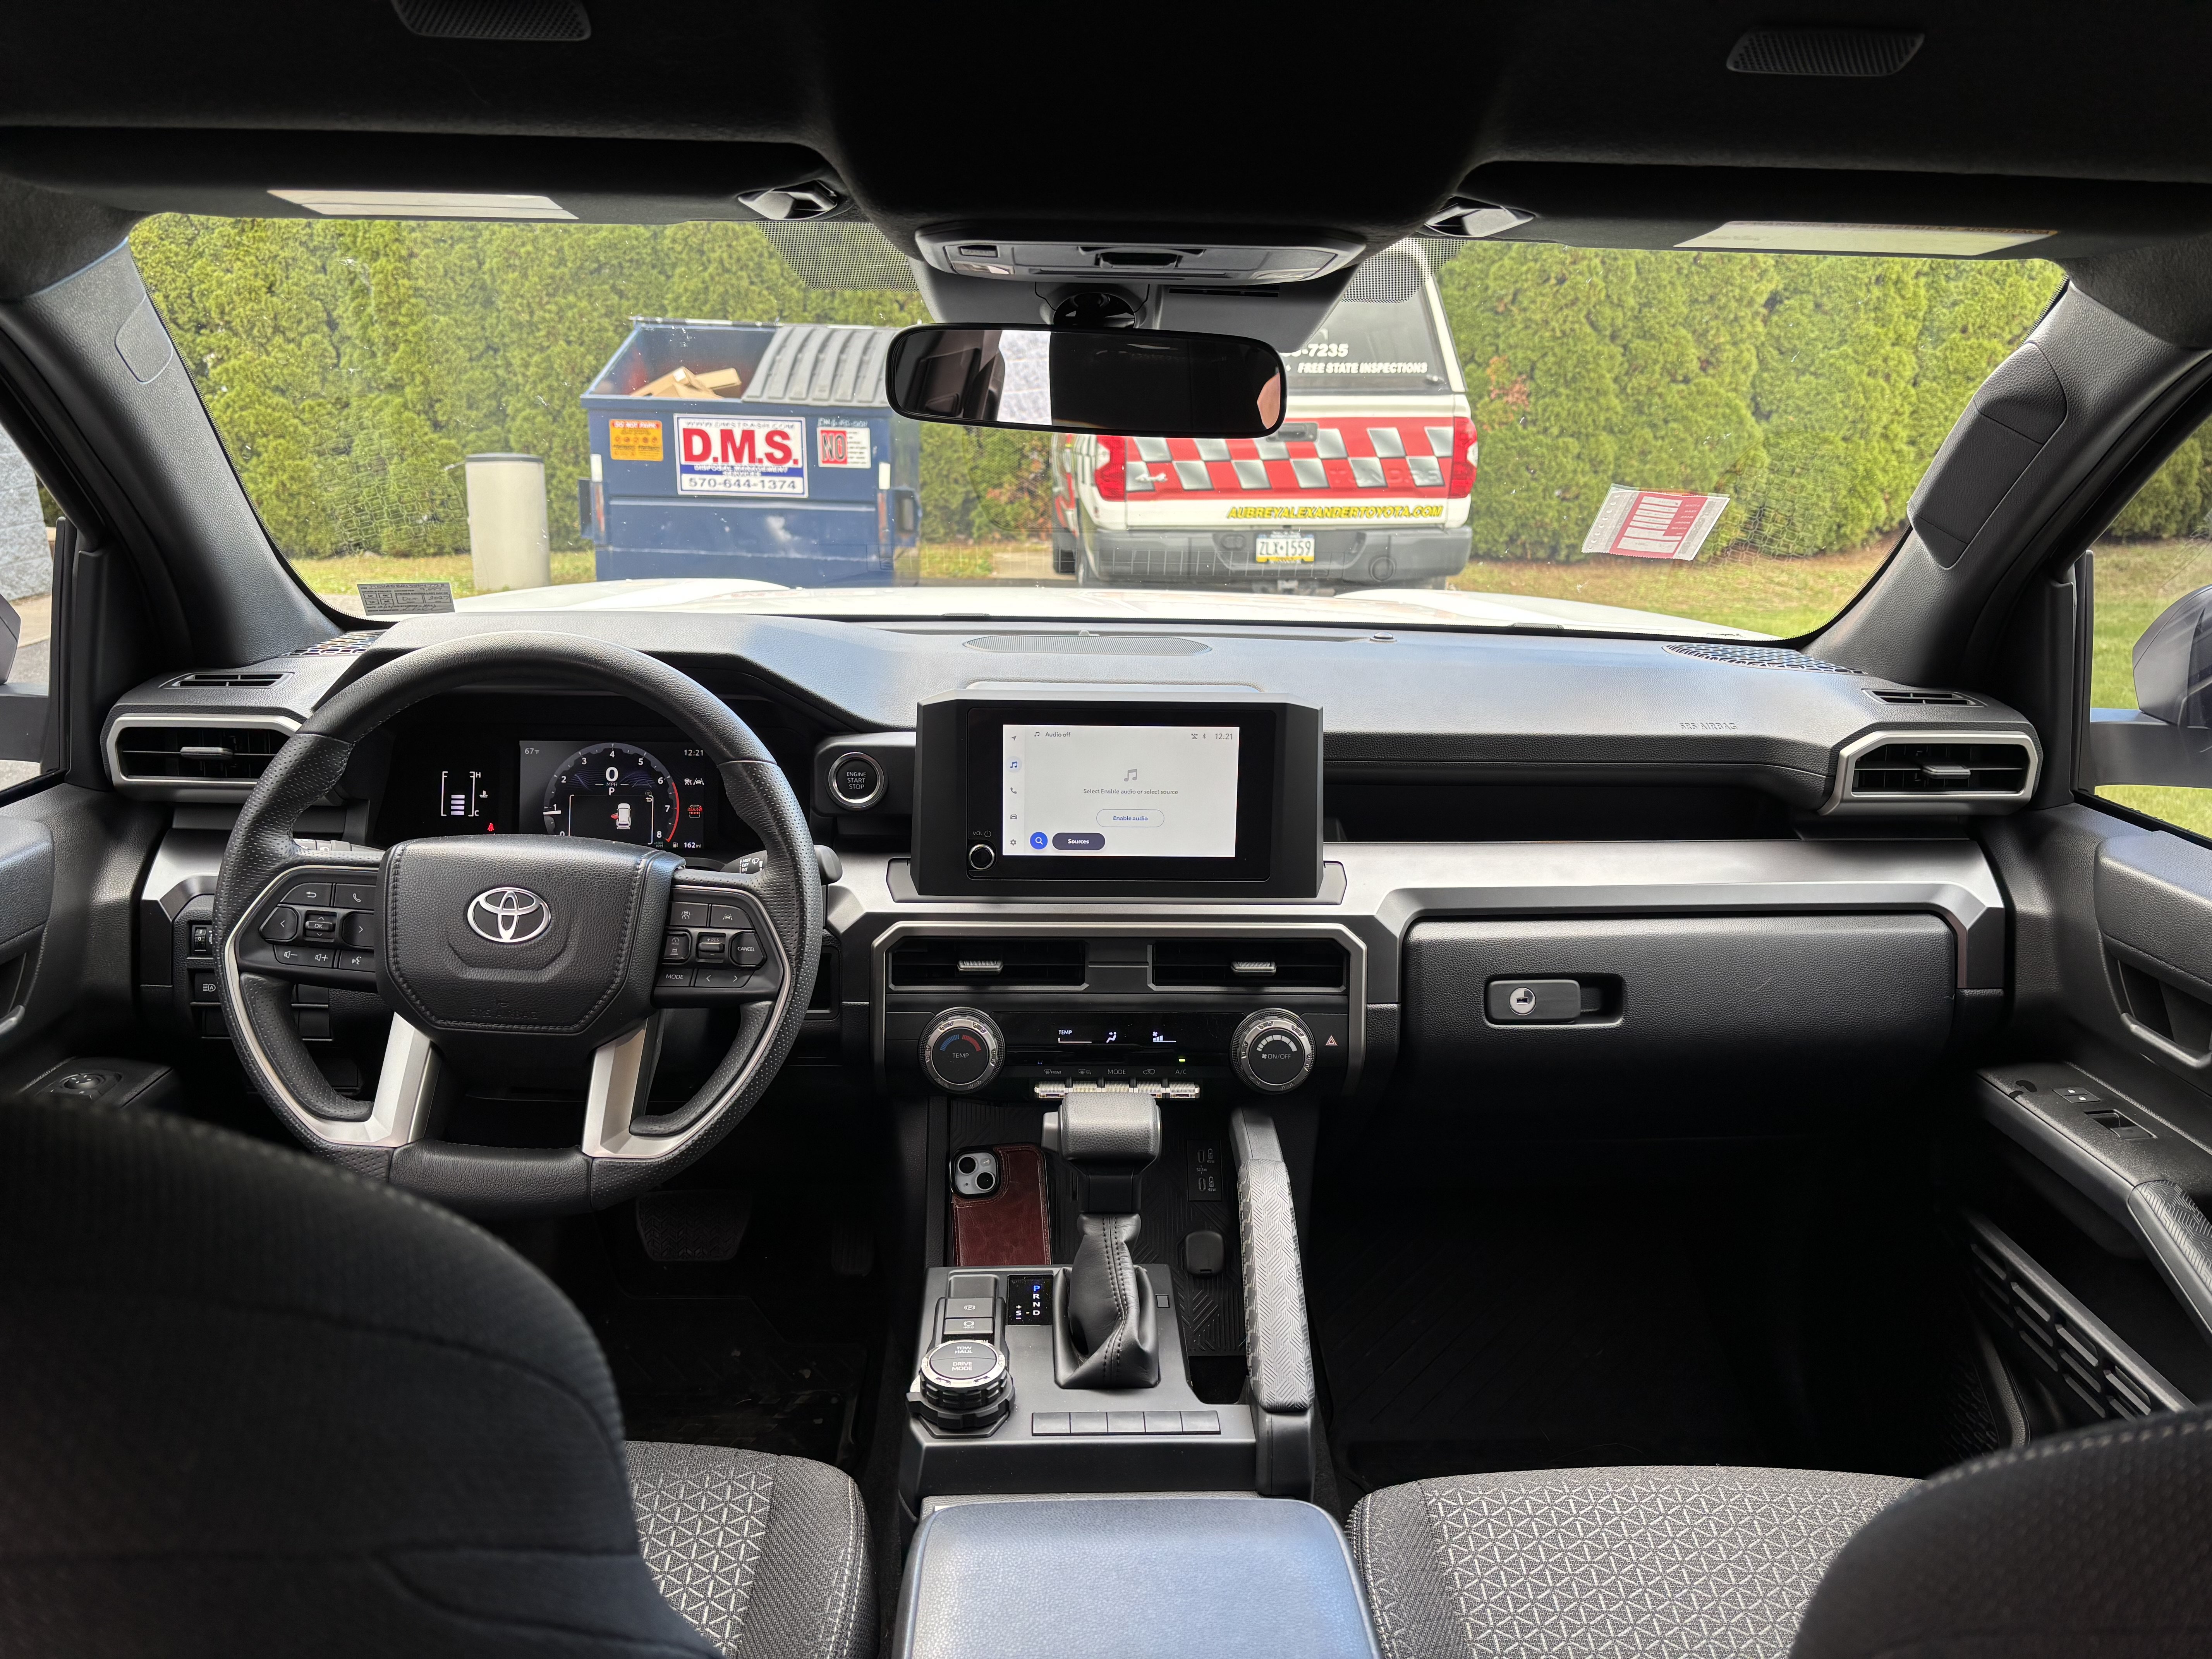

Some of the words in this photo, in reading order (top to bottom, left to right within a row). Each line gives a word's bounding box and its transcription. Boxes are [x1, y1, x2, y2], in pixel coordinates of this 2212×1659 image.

[1297, 362, 1326, 374] FREE
[1326, 362, 1359, 374] STATE
[1359, 362, 1428, 374] INSPECTIONS
[683, 428, 799, 465] D.M.S.
[822, 433, 846, 460] NO
[689, 477, 796, 491] 570-644-1374
[1227, 506, 1444, 519] AUBREYALEXANDERTOYOTA.COM
[605, 766, 618, 781] 0
[609, 787, 615, 796] P
